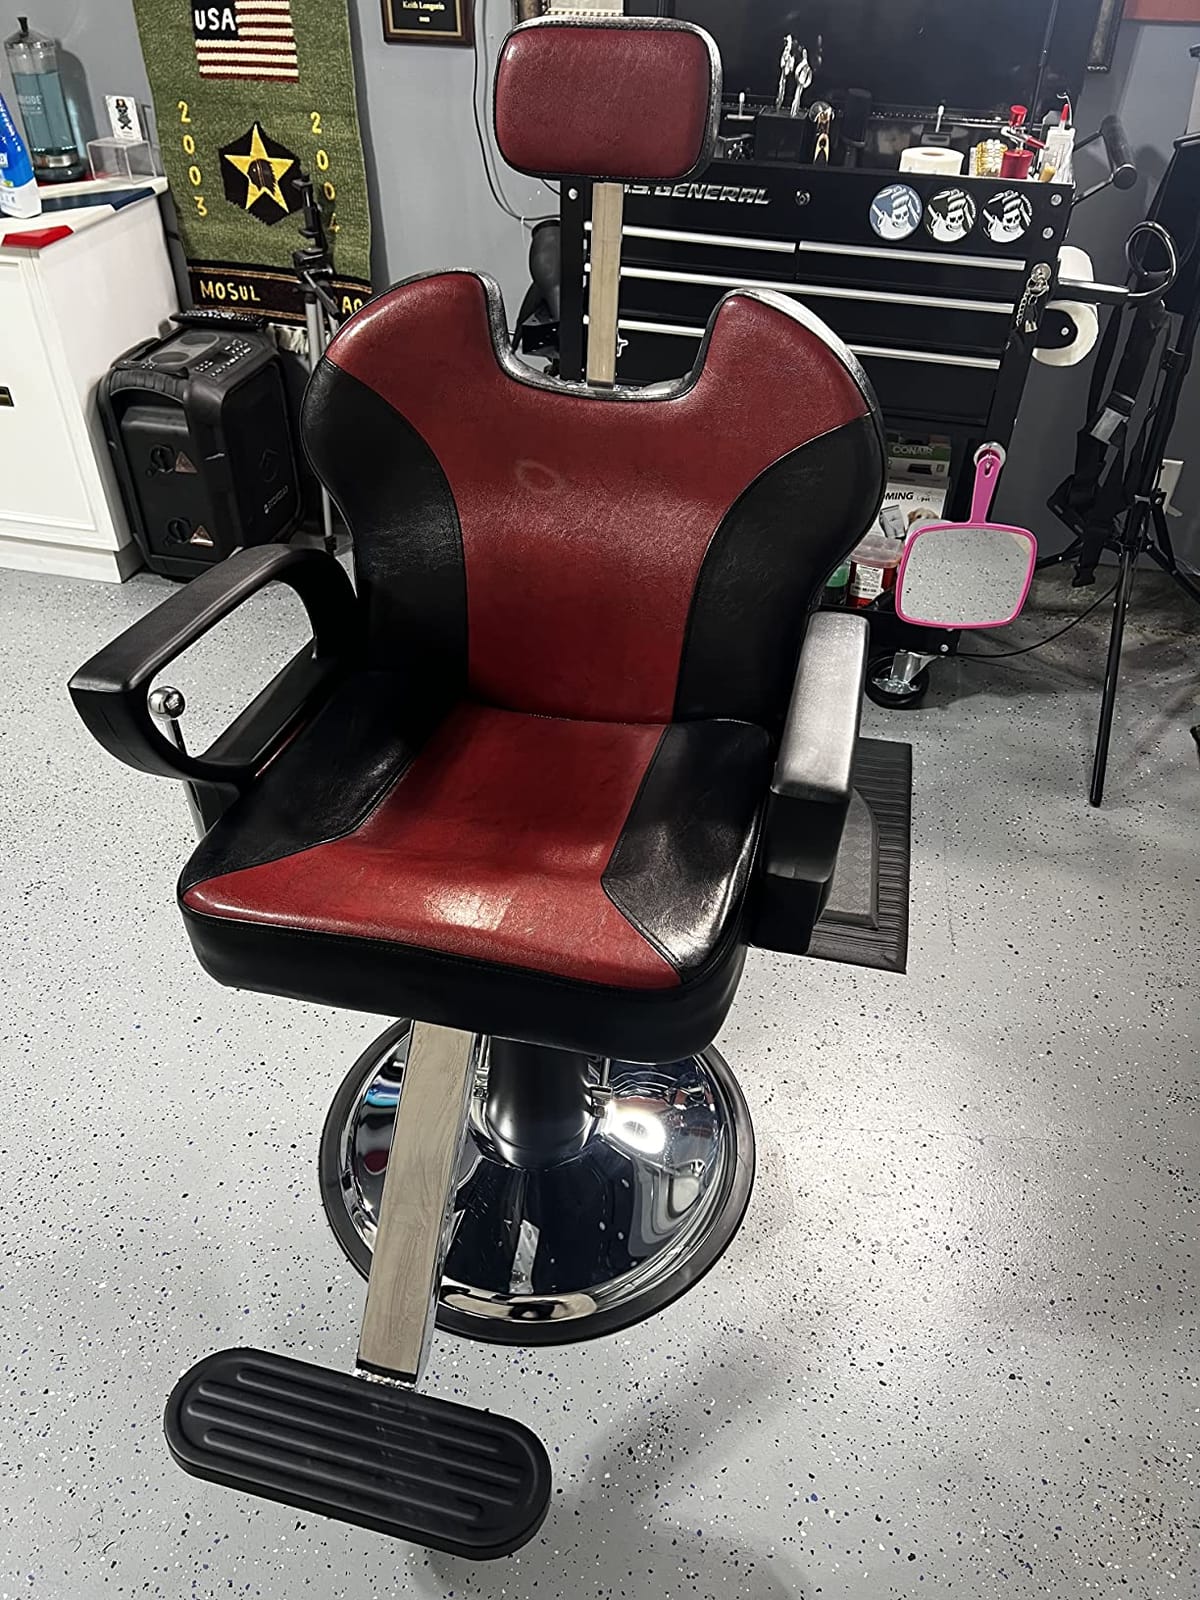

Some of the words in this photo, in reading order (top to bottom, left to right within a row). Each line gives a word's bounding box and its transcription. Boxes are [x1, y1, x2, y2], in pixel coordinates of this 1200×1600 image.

[194, 7, 236, 31] USA
[654, 182, 771, 205] GENERAL
[200, 280, 261, 302] MOSUL
[892, 445, 933, 455] CONAIR
[884, 491, 915, 502] MING
